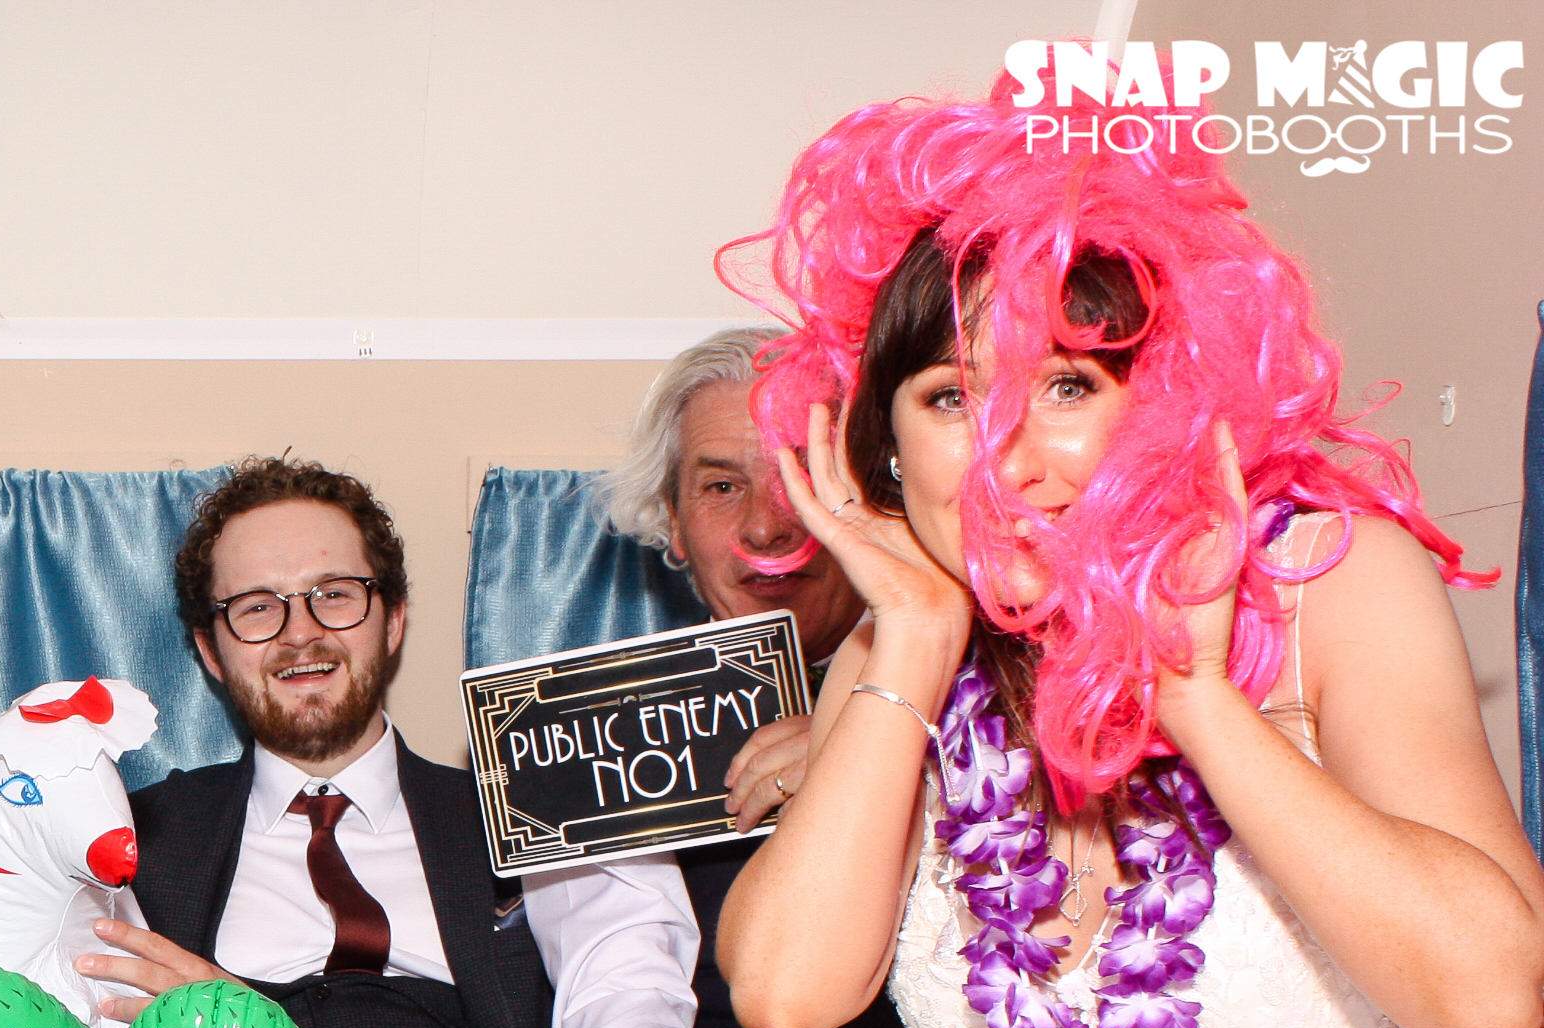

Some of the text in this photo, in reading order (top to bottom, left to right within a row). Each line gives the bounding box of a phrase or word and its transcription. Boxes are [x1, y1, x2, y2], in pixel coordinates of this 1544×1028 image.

[508, 685, 764, 771] PUBLIC ENEMY
[592, 744, 698, 807] NO1
